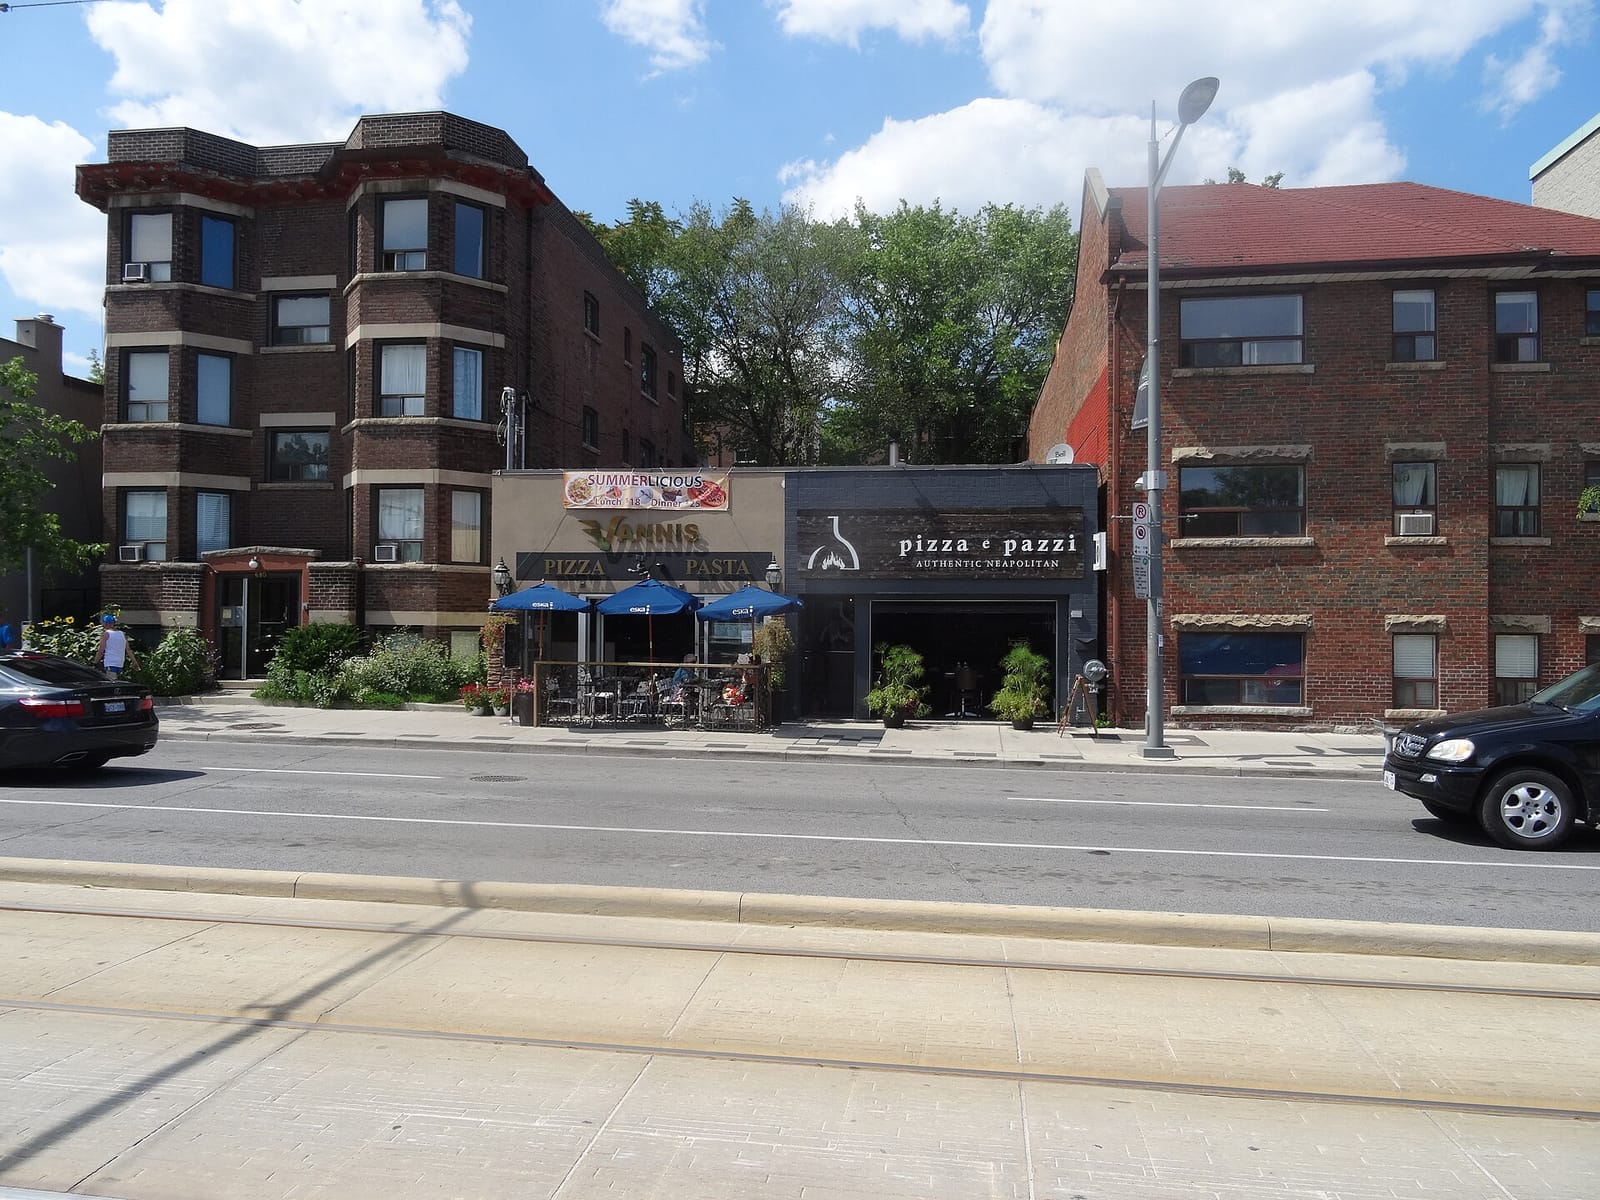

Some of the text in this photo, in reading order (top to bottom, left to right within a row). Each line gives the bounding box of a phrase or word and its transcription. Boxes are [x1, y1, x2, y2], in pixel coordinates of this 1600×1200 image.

[587, 474, 703, 488] SUMMERLICIOUS
[595, 497, 622, 506] Lunch
[651, 498, 682, 508] Dinner
[899, 534, 1077, 557] pizza e pazzi
[543, 558, 752, 575] PIZZA PASTA
[916, 559, 1060, 568] AUTHENTIC NEAPOLITAN
[629, 606, 646, 614] eska
[732, 607, 749, 616] eska
